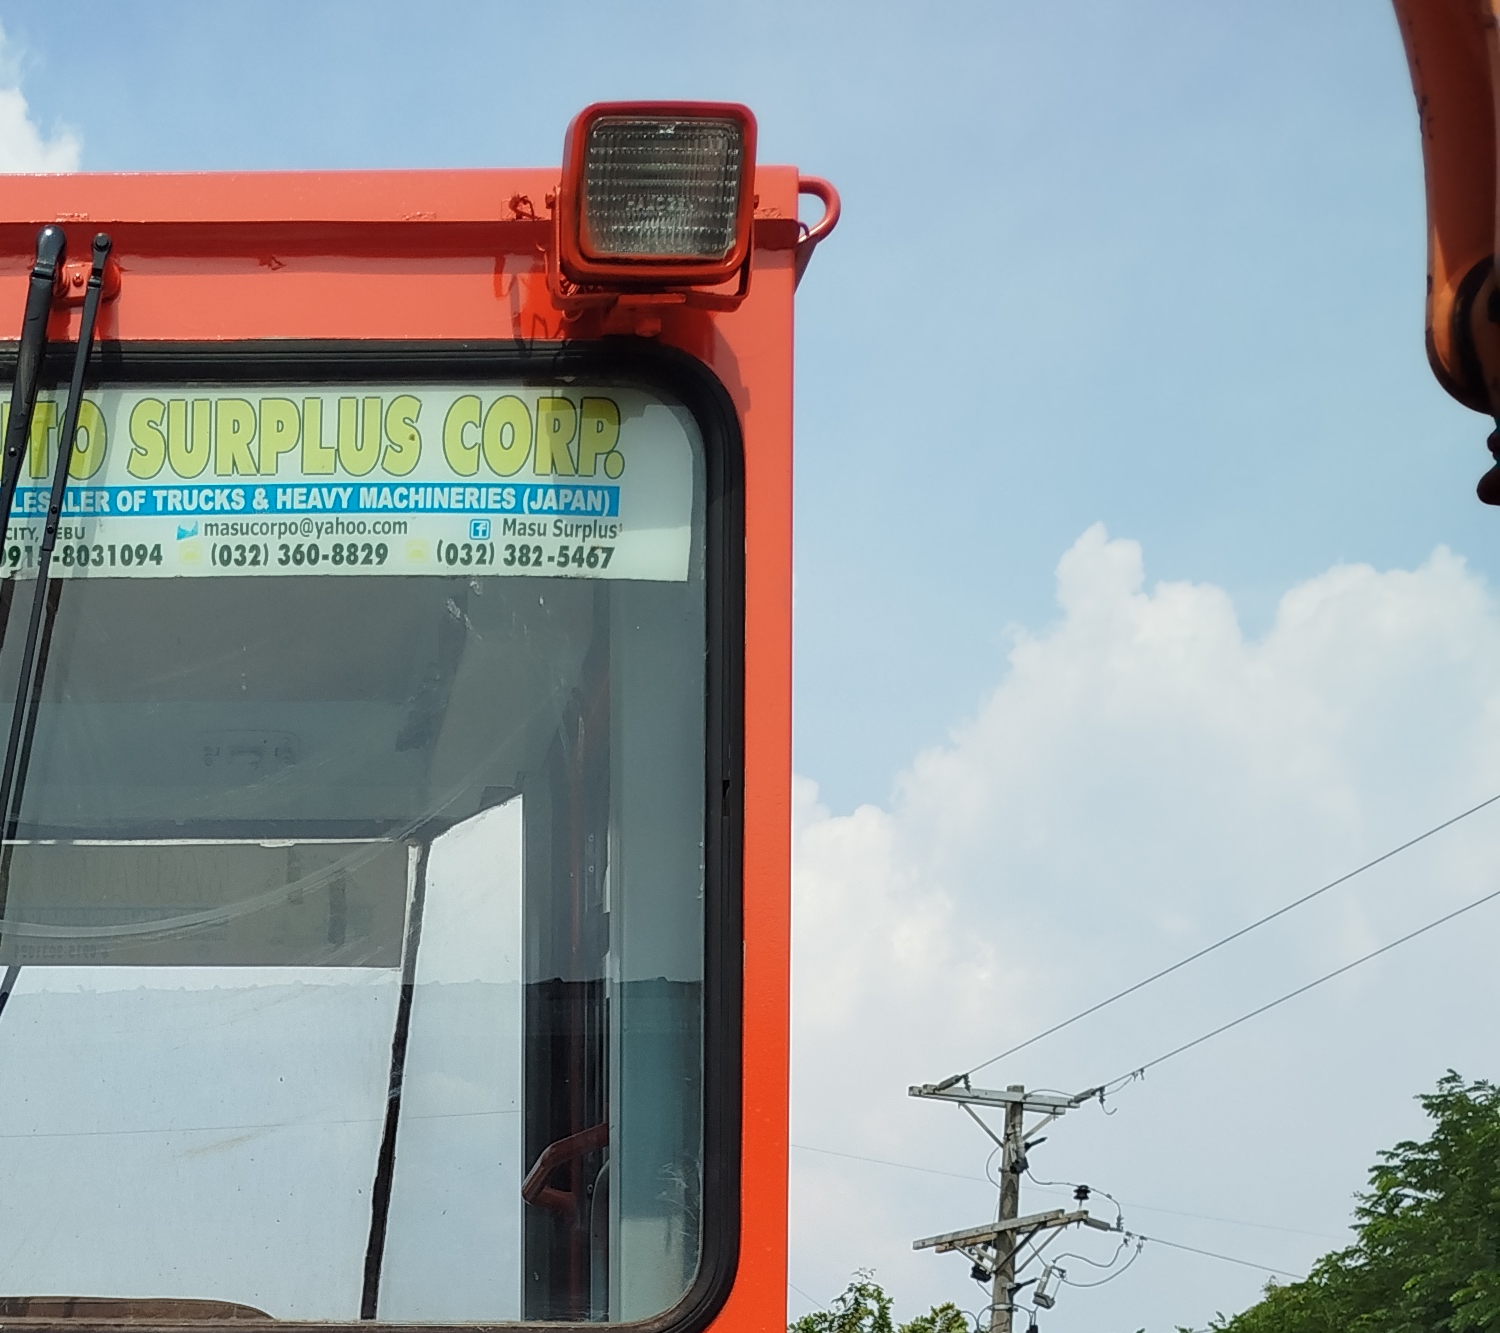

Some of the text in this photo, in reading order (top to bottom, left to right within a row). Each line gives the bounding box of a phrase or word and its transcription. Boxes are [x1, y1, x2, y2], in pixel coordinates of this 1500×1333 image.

[127, 396, 423, 479] SURPLUS
[443, 396, 625, 479] CORP.
[116, 490, 147, 512] OF
[152, 488, 246, 512] TRUCKS
[252, 487, 269, 510] &
[276, 487, 353, 510] HEAVY
[359, 486, 516, 509] MACHINERIES
[523, 487, 610, 517] (JAPAN)
[204, 516, 408, 540] masucorpo@yahoo.com
[502, 517, 618, 543] Masu Surplus
[211, 542, 389, 567] (032) 360-8829
[436, 539, 616, 569] (032) 382-5467
